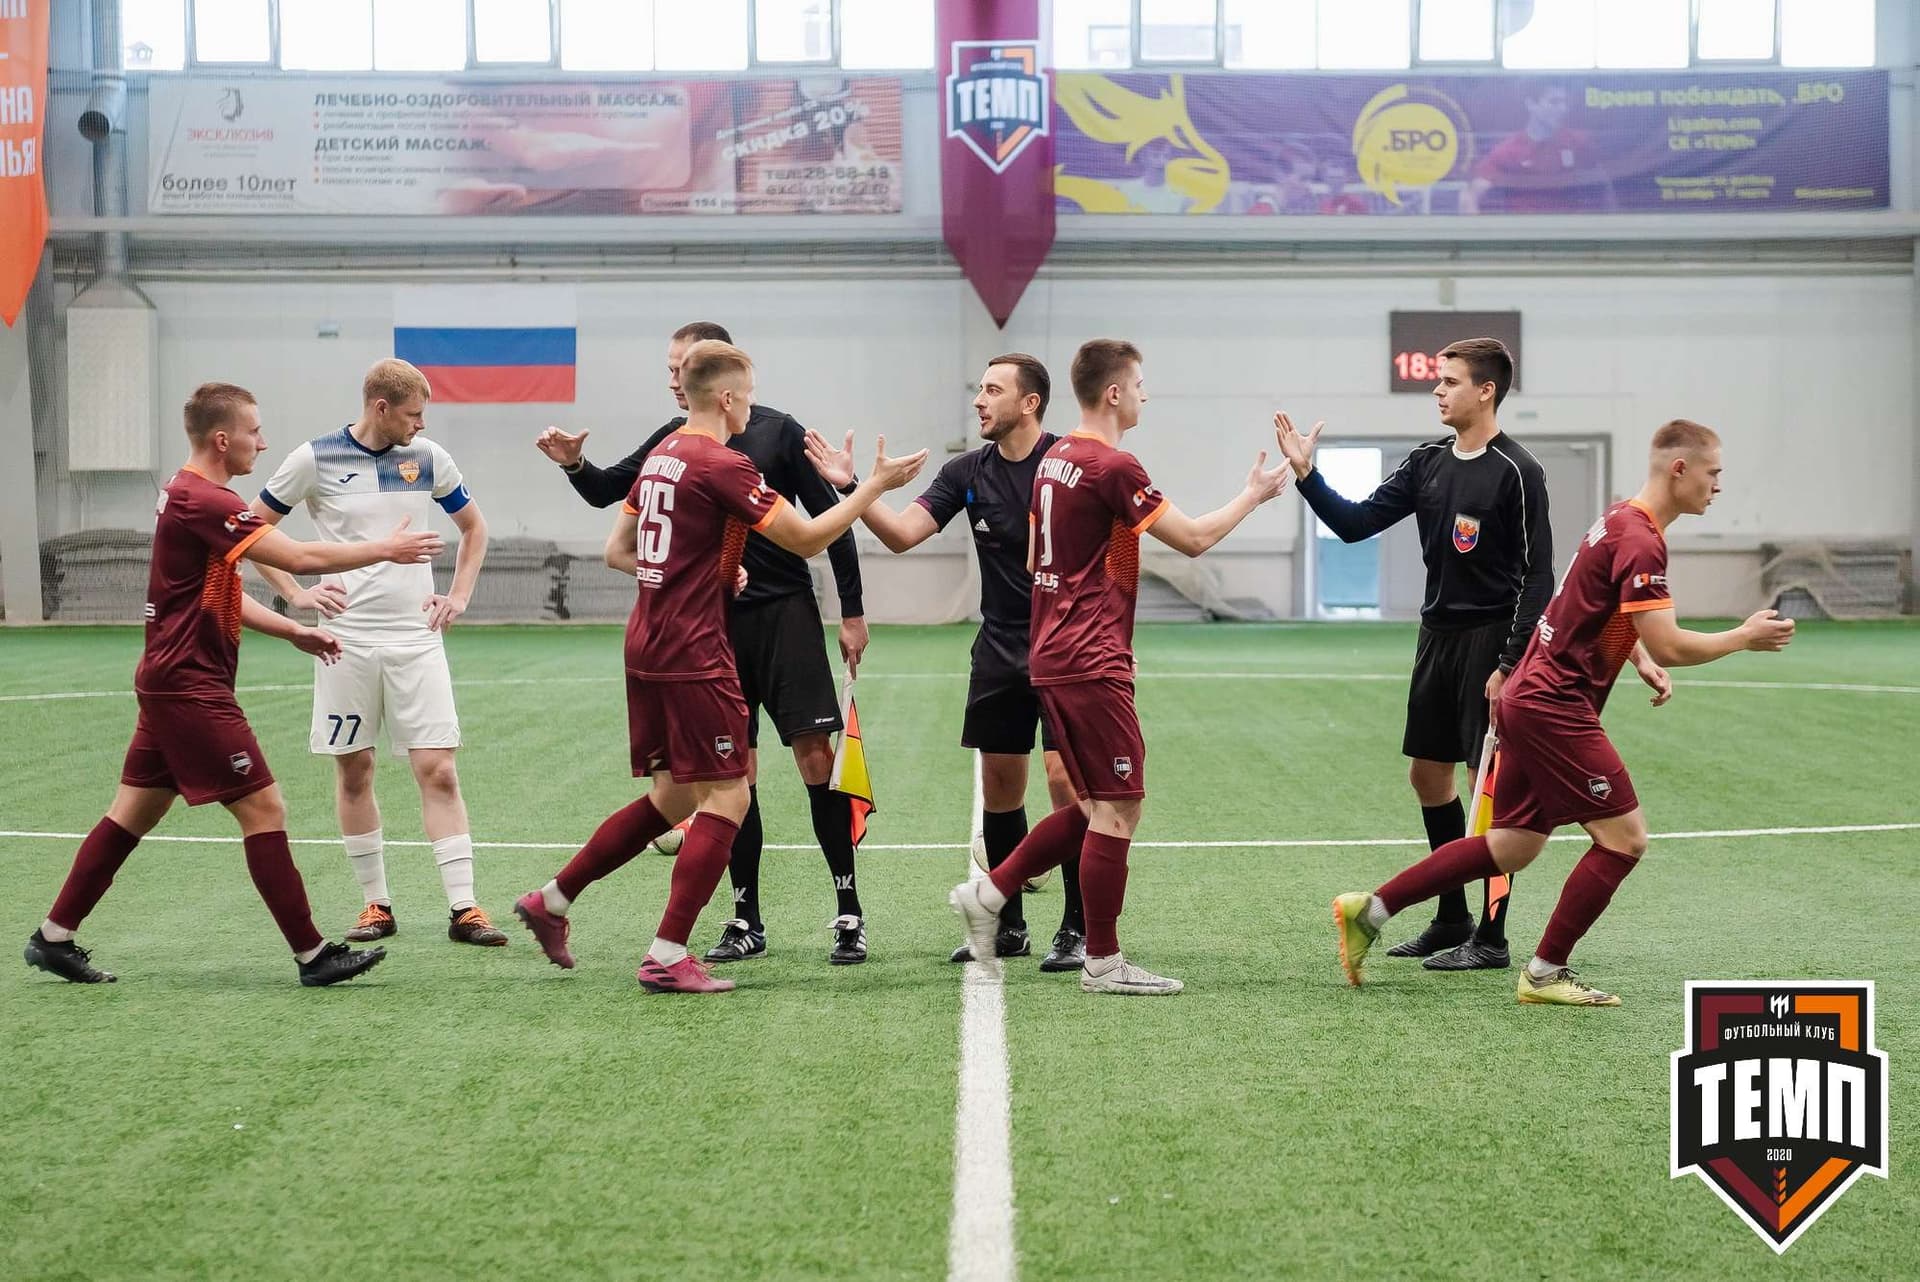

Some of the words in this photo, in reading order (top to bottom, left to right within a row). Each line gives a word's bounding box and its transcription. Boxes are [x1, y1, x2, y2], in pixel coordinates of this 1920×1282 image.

[315, 92, 591, 109] ЛЕЧЕБНО-ОЗДОРОВИТЕЛЬНЫЙ
[957, 78, 1040, 122] ТЕМП
[1586, 86, 1654, 108] Время
[813, 100, 872, 131] 20%
[187, 128, 274, 141] ЭКСКЛЮЗИВ
[315, 136, 400, 152] ДЕТСКИЙ
[405, 138, 492, 152] МАССАЖ:
[1382, 129, 1446, 151] .БРО
[162, 173, 228, 191] более
[239, 174, 297, 191] 10лет
[637, 479, 675, 564] 25
[328, 714, 362, 746] 77
